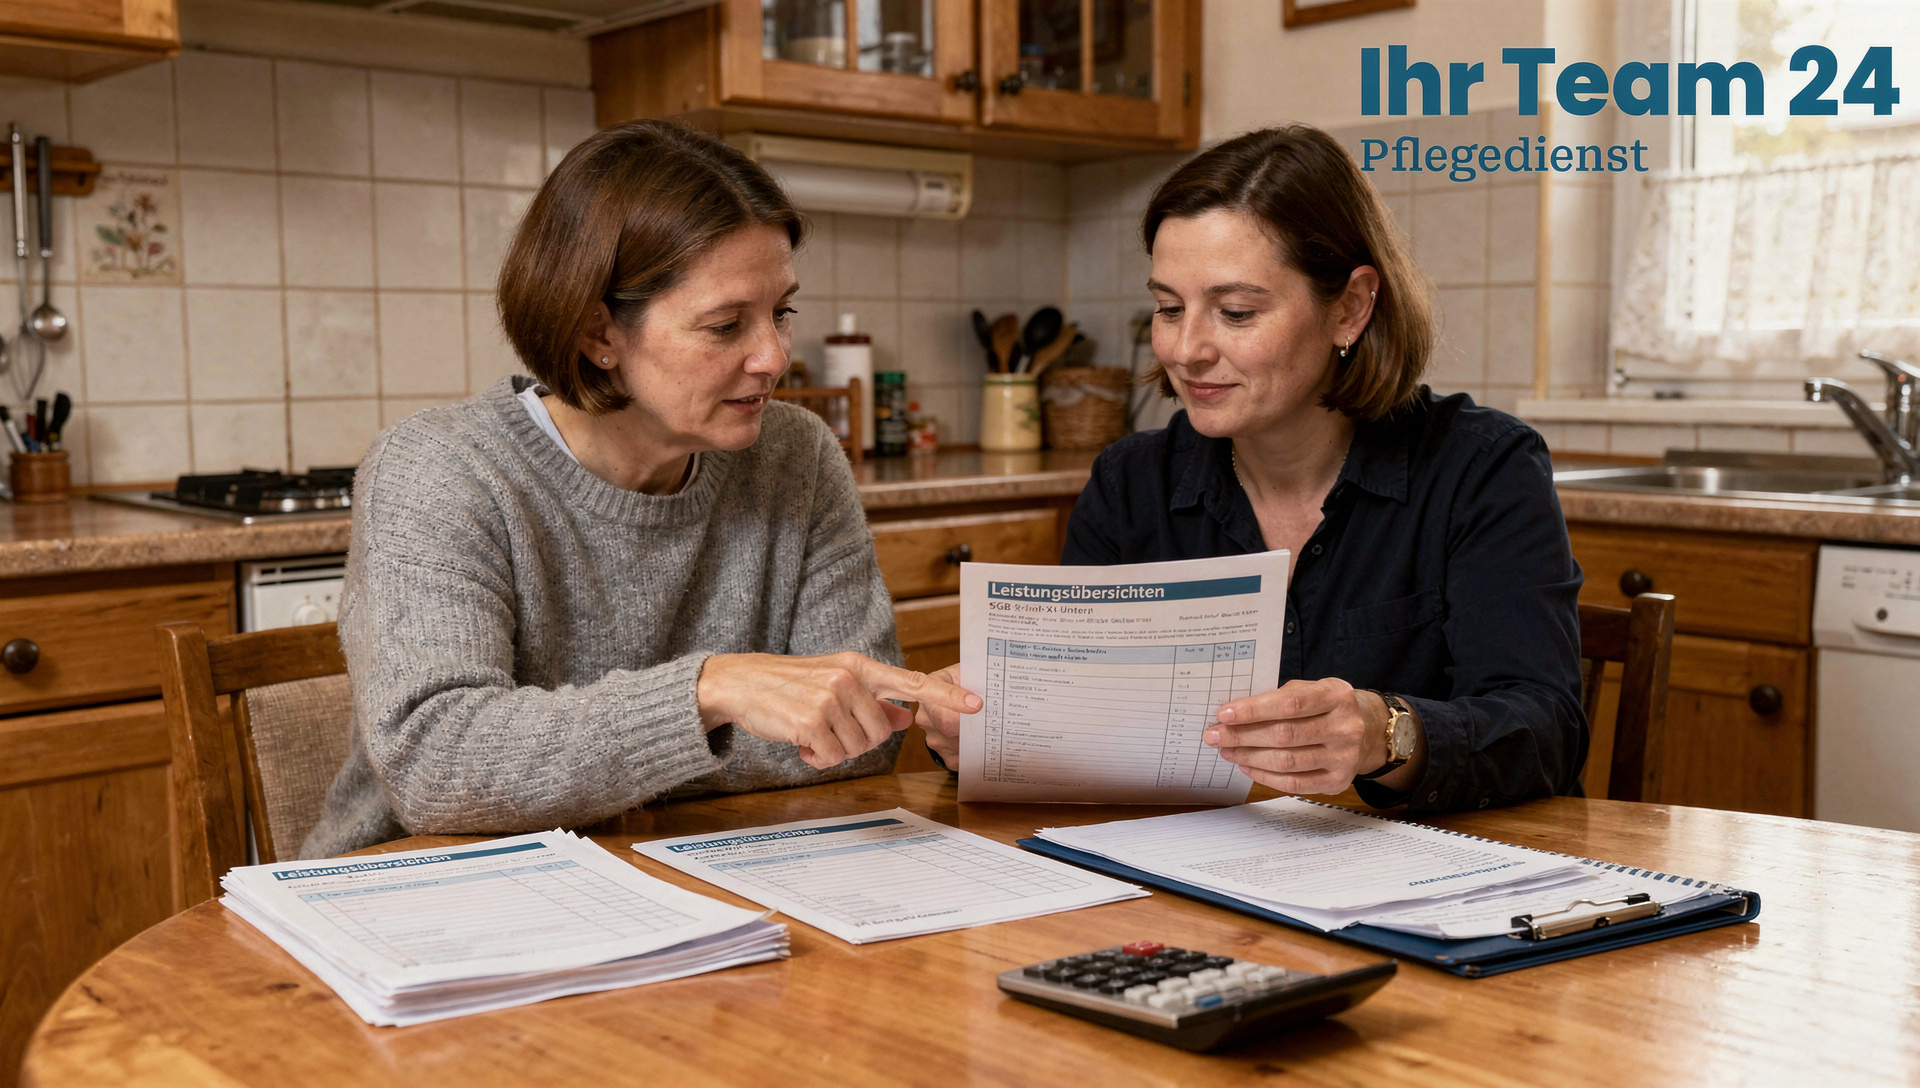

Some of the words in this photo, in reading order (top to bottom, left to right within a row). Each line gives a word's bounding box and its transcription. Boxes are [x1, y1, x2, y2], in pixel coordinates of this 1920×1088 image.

[991, 582, 1165, 602] Leistungsübersichten
[673, 828, 820, 851] Leistungsübersichten
[277, 854, 452, 880] Leistungsübersichten
